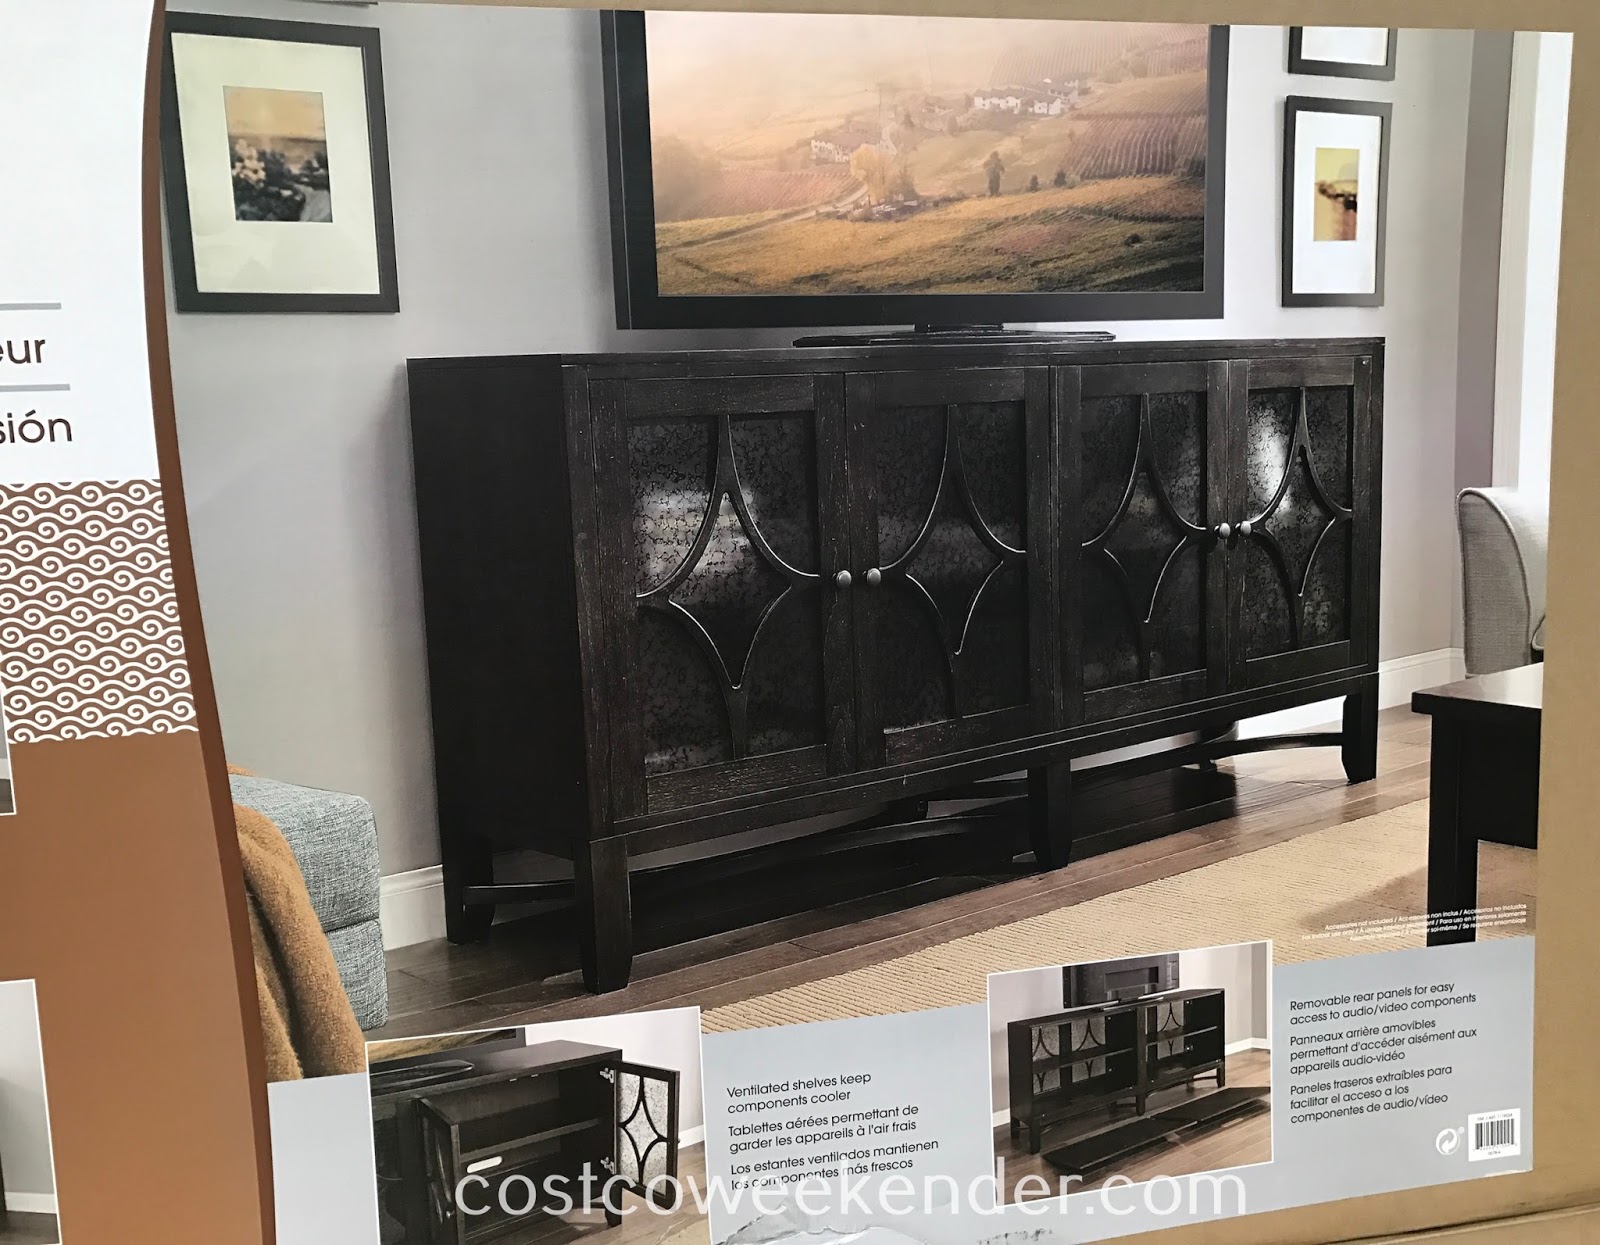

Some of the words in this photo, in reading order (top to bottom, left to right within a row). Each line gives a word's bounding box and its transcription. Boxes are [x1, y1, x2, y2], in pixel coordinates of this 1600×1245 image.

[0, 339, 46, 365] ur
[1290, 994, 1350, 1010] Removable
[1354, 992, 1374, 1003] rear
[1377, 986, 1412, 1002] panels
[1414, 985, 1428, 996] for
[1430, 982, 1455, 994] easy
[1290, 1012, 1328, 1025] access
[1329, 1010, 1340, 1020] to
[1342, 1002, 1408, 1018] audio/video
[1410, 994, 1476, 1011] components
[1290, 1031, 1344, 1046] Panneaux
[1346, 1026, 1380, 1038] arrière
[1382, 1019, 1436, 1034] amovibles
[1290, 1044, 1348, 1062] permettant
[1350, 1036, 1405, 1052] d'accéder
[1408, 1030, 1456, 1045] aisément
[1458, 1029, 1477, 1038] aux
[1290, 1059, 1340, 1075] appareils
[1342, 1050, 1406, 1067] audio-vidéo
[727, 1081, 789, 1098] Ventilated
[792, 1076, 837, 1090] shelves
[840, 1072, 872, 1087] keep
[1290, 1081, 1331, 1095] Paneles
[1334, 1076, 1373, 1089] traseros
[1376, 1068, 1425, 1084] extraíbles
[1427, 1066, 1452, 1078] para
[728, 1094, 808, 1114] components
[810, 1090, 851, 1104] cooler
[1290, 1097, 1328, 1109] facilitar
[1331, 1094, 1340, 1104] el
[1343, 1090, 1382, 1102] acceso
[1384, 1088, 1392, 1096] a
[1394, 1084, 1409, 1094] los
[1290, 1105, 1364, 1124] componentes
[1366, 1102, 1380, 1112] de
[1384, 1094, 1448, 1110] audio/vídeo
[728, 1120, 783, 1136] Tablettes
[786, 1115, 828, 1130] aérées
[832, 1106, 900, 1126] permettant
[902, 1104, 919, 1116] de
[729, 1137, 772, 1154] garder
[775, 1135, 792, 1147] les
[796, 1128, 854, 1146] appareils
[857, 1124, 866, 1136] à
[868, 1123, 890, 1135] l'air
[892, 1119, 916, 1132] frais
[730, 1164, 750, 1175] Los
[754, 1156, 805, 1172] estantes
[808, 1148, 870, 1165] ventilados
[874, 1140, 939, 1158] mantienen
[731, 1180, 749, 1190] los
[752, 1168, 839, 1187] componentes
[842, 1162, 868, 1176] más
[871, 1160, 913, 1173] frescos
